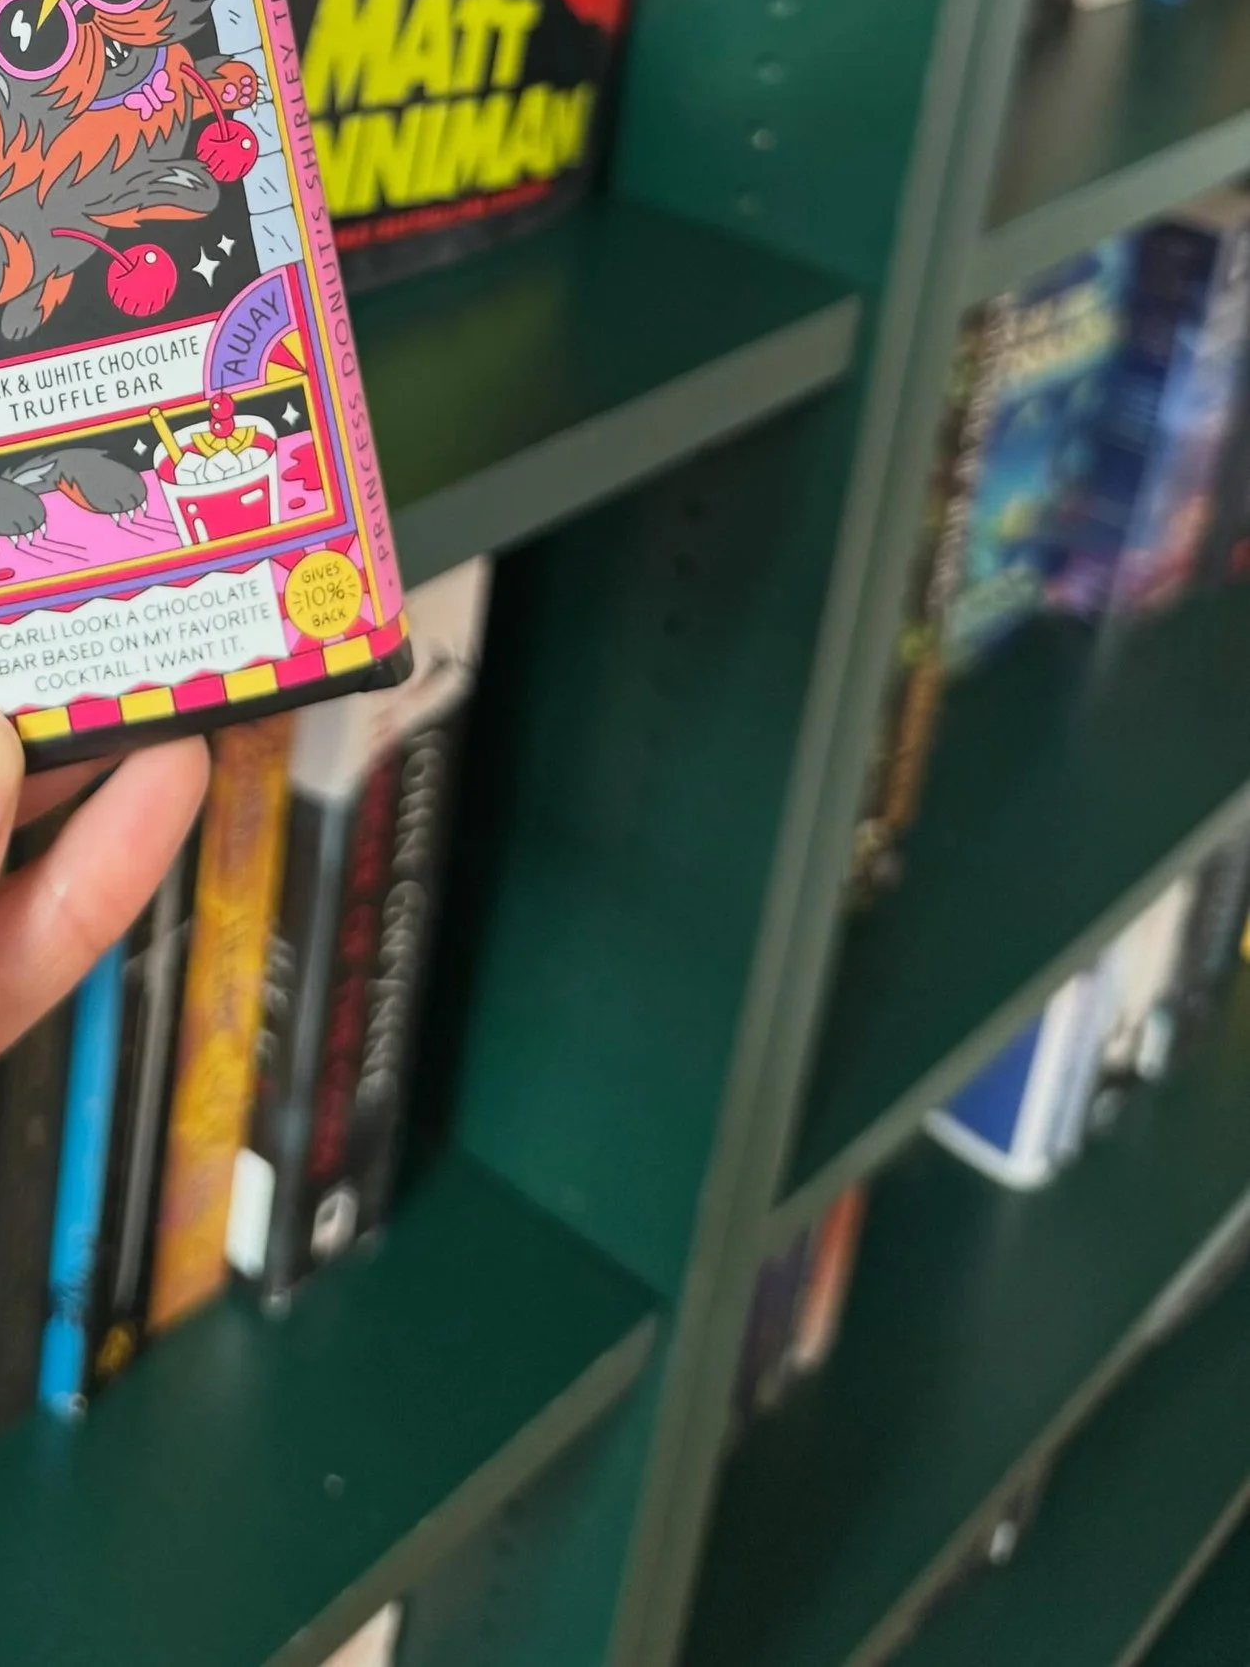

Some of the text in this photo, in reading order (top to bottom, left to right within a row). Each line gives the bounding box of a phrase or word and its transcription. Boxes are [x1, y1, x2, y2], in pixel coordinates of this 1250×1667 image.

[279, 47, 321, 190] SHIRLEY
[311, 209, 357, 378] DONUT'S
[222, 290, 283, 375] AWAY
[18, 373, 31, 394] &
[35, 361, 93, 391] WHITE
[98, 336, 201, 380] CHOCOLATE
[9, 372, 164, 423] TRUFFLE BAR
[349, 396, 390, 563] PRINCESS
[300, 561, 342, 584] GIVES
[301, 579, 346, 607] 10%
[43, 639, 105, 667] BASED
[108, 631, 139, 655] ON
[142, 624, 174, 648] MY
[178, 602, 271, 640] FAVORITE
[61, 612, 123, 640] LOOK!
[125, 607, 140, 625] A
[143, 579, 261, 620] CHOCOLATE
[310, 606, 348, 628] BACK
[34, 635, 245, 695] COCKTAIL. I WANT IT.
